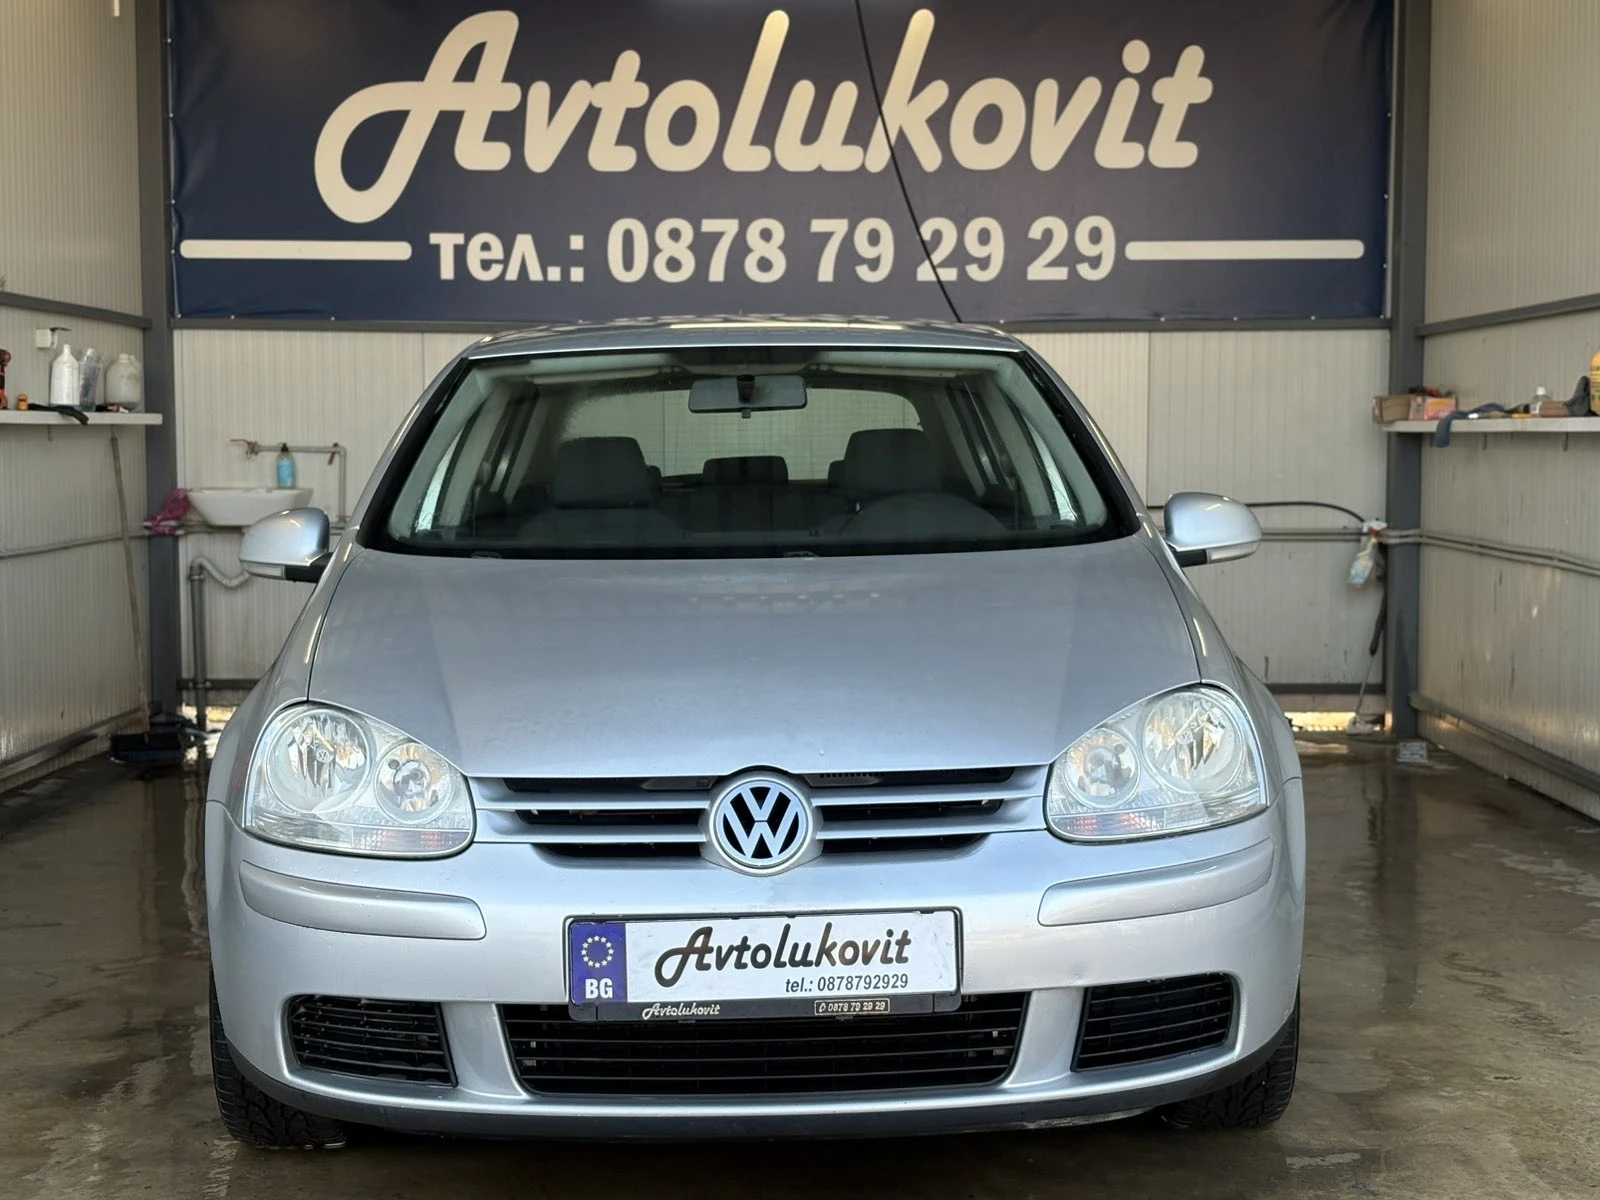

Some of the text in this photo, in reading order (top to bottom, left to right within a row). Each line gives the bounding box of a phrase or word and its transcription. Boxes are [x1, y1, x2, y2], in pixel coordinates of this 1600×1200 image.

[314, 9, 1213, 223] Avtolukovit
[429, 216, 1116, 283] тел.: 0878 79 29 29
[715, 779, 808, 868] VW
[654, 922, 912, 988] Avtolukovit
[585, 978, 614, 999] BG
[785, 973, 909, 993] tel.: 0878792929
[641, 1002, 721, 1020] Avtolukovit
[827, 1001, 886, 1012] 0878 79 29 29
